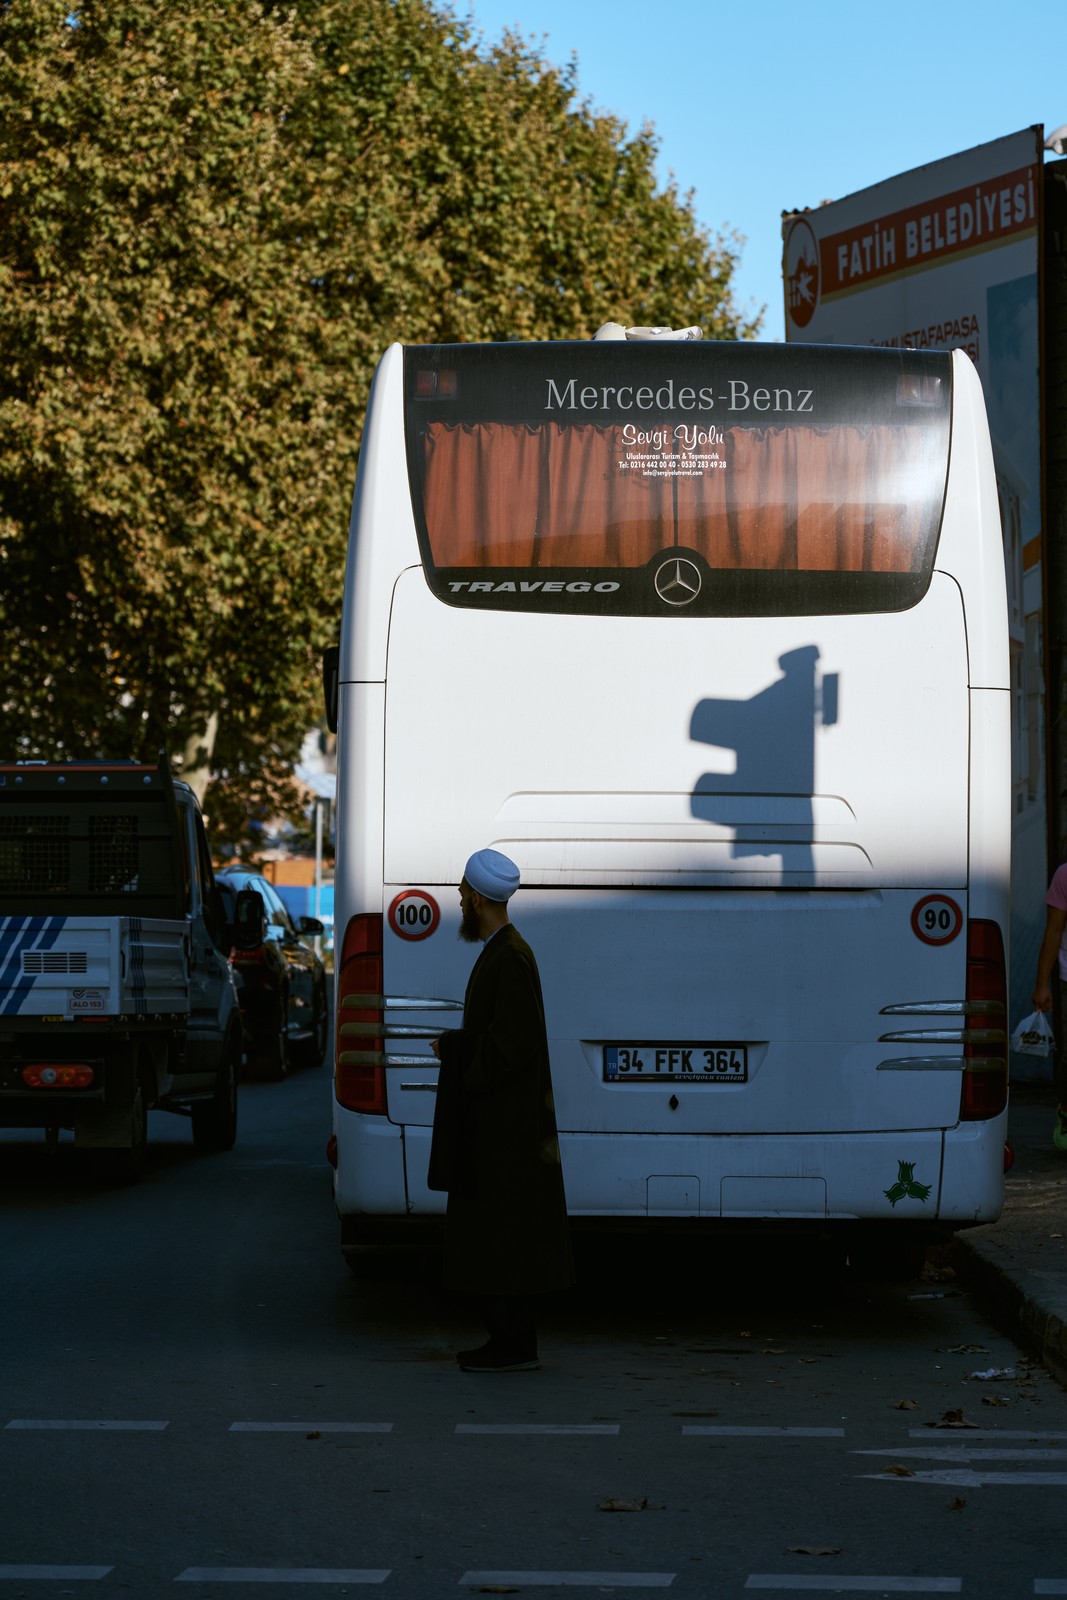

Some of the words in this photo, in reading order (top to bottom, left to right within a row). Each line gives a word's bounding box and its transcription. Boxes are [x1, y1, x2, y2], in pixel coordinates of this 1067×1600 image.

[837, 222, 897, 282] FATİH
[905, 168, 1036, 259] BELEDİYESİ
[544, 379, 814, 412] Mercedes-Benz
[621, 424, 669, 450] Sevgi
[674, 424, 725, 451] Yolu
[618, 461, 629, 469] Tel:
[630, 461, 645, 469] 0216
[647, 461, 658, 469] 442
[659, 461, 668, 469] 00
[668, 461, 677, 469] 40
[681, 461, 696, 469] 0530
[698, 461, 709, 469] 283
[710, 461, 718, 469] 49
[719, 461, 727, 469] 28
[626, 452, 660, 460] Uluslararası
[661, 452, 681, 460] Turizm
[682, 452, 687, 460] &
[448, 581, 621, 593] TRAVEGO
[398, 904, 431, 925] 100
[924, 909, 951, 930] 90
[608, 1062, 618, 1071] TR
[618, 1050, 643, 1072] 34
[655, 1050, 693, 1072] FFK
[703, 1050, 741, 1072] 364
